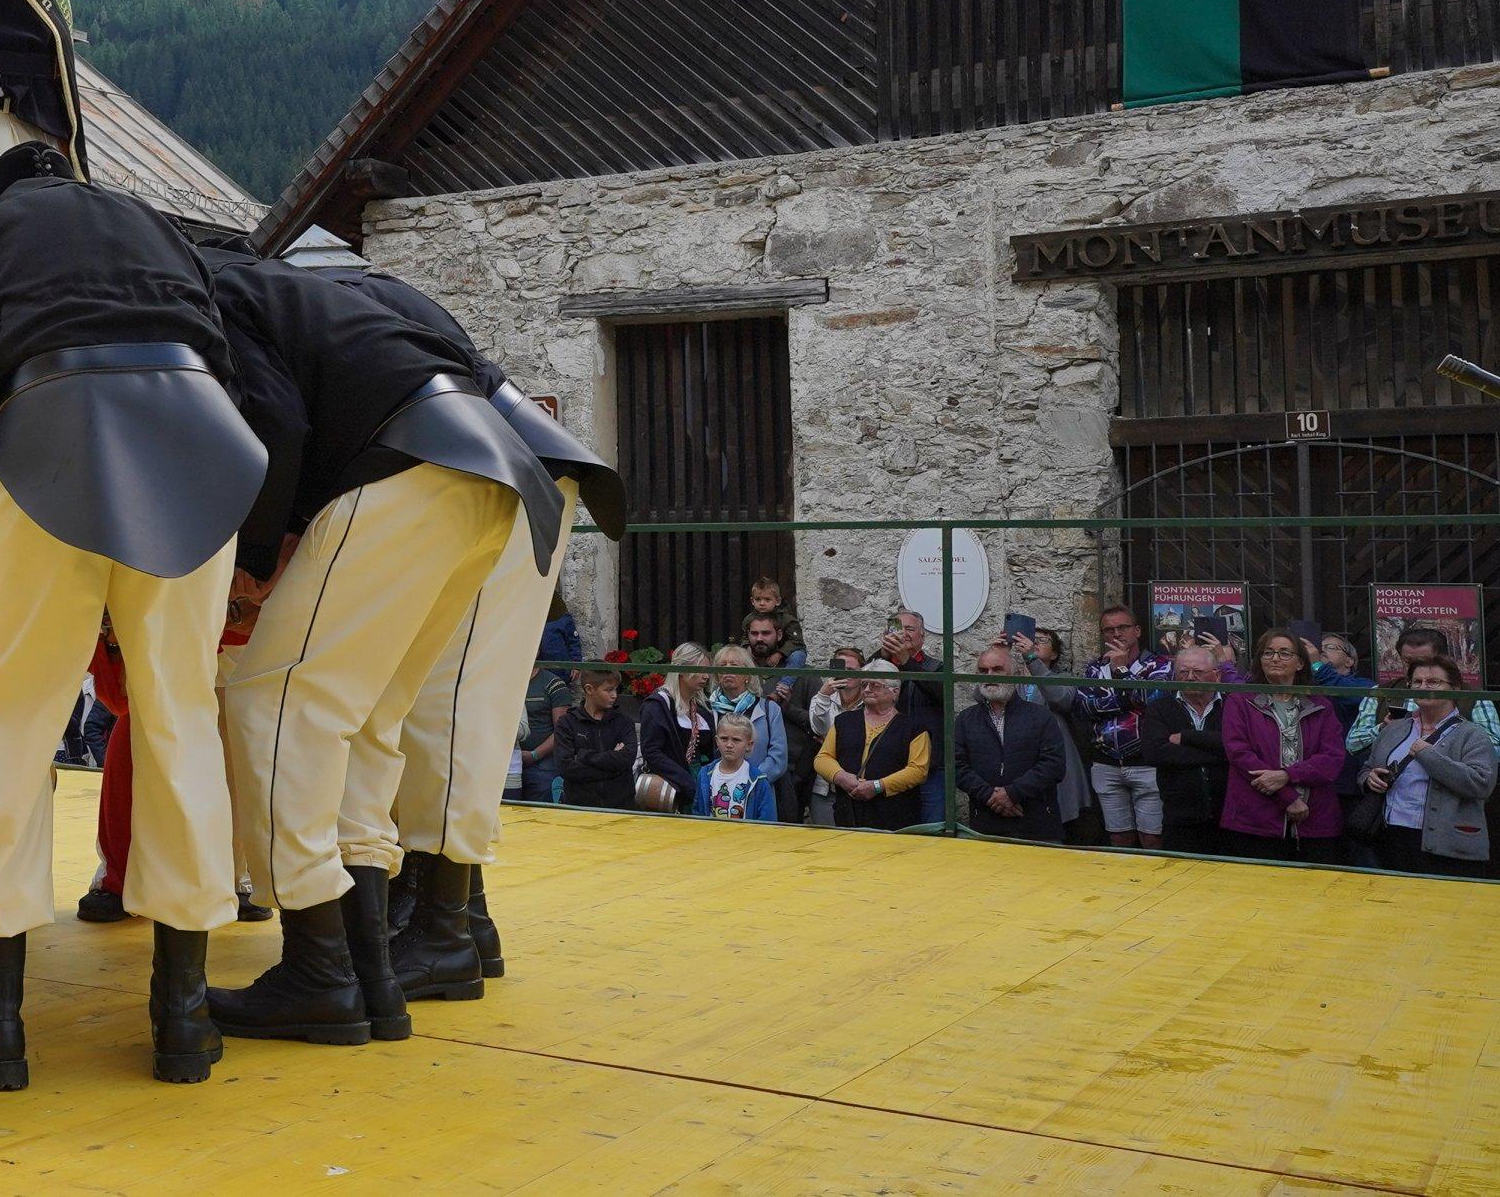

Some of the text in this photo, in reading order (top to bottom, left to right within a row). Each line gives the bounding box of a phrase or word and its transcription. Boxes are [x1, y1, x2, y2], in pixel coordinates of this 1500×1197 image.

[1296, 412, 1318, 432] 10
[1154, 586, 1242, 594] MONTAN MUSEUM
[1376, 589, 1425, 597] MONTAN
[1154, 593, 1215, 602] FÜHRUNGEN
[1376, 598, 1422, 606] MUSEUM
